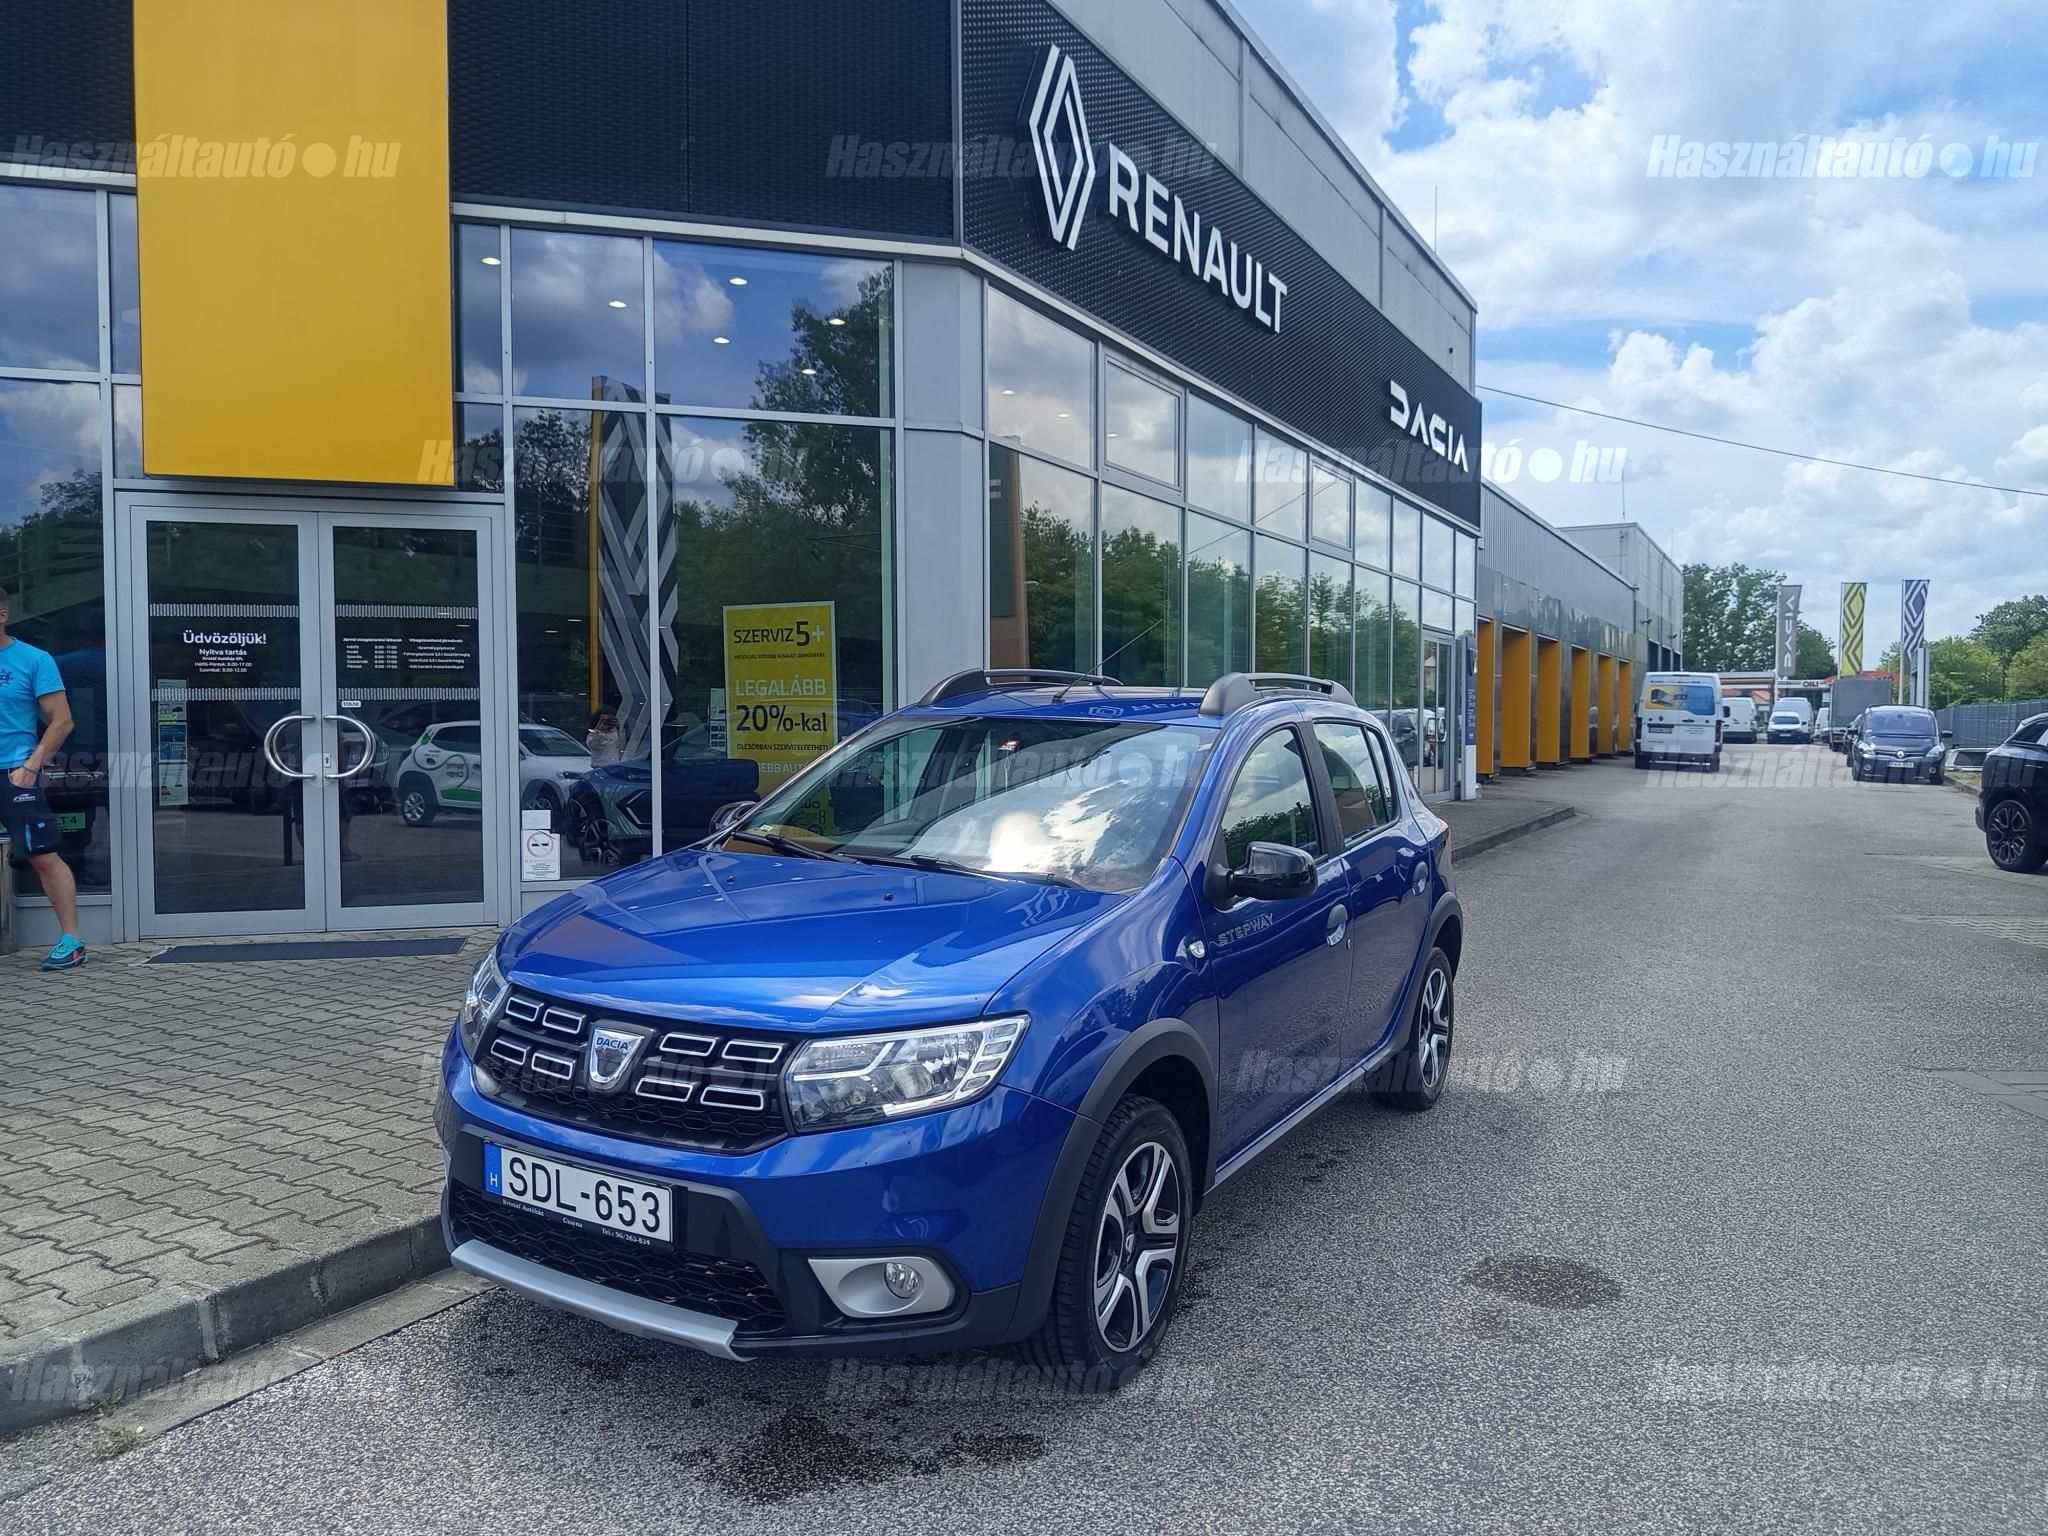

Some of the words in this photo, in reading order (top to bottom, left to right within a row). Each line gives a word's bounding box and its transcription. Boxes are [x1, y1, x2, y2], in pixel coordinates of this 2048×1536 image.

[1109, 143, 1287, 333] RENAULT
[1390, 380, 1468, 473] DACIA
[182, 630, 267, 647] Üdvözöljük!
[733, 627, 794, 644] SZERVIZ
[1784, 595, 1796, 667] DACIA
[199, 648, 224, 657] Nyitva
[225, 648, 247, 656] tartás
[735, 674, 827, 697] LEGALÁBB
[735, 704, 828, 732] 20%-kal
[1217, 913, 1274, 946] STEPWAY
[595, 1036, 630, 1052] DACIA
[490, 1172, 499, 1188] H
[508, 1156, 661, 1233] SDL-653
